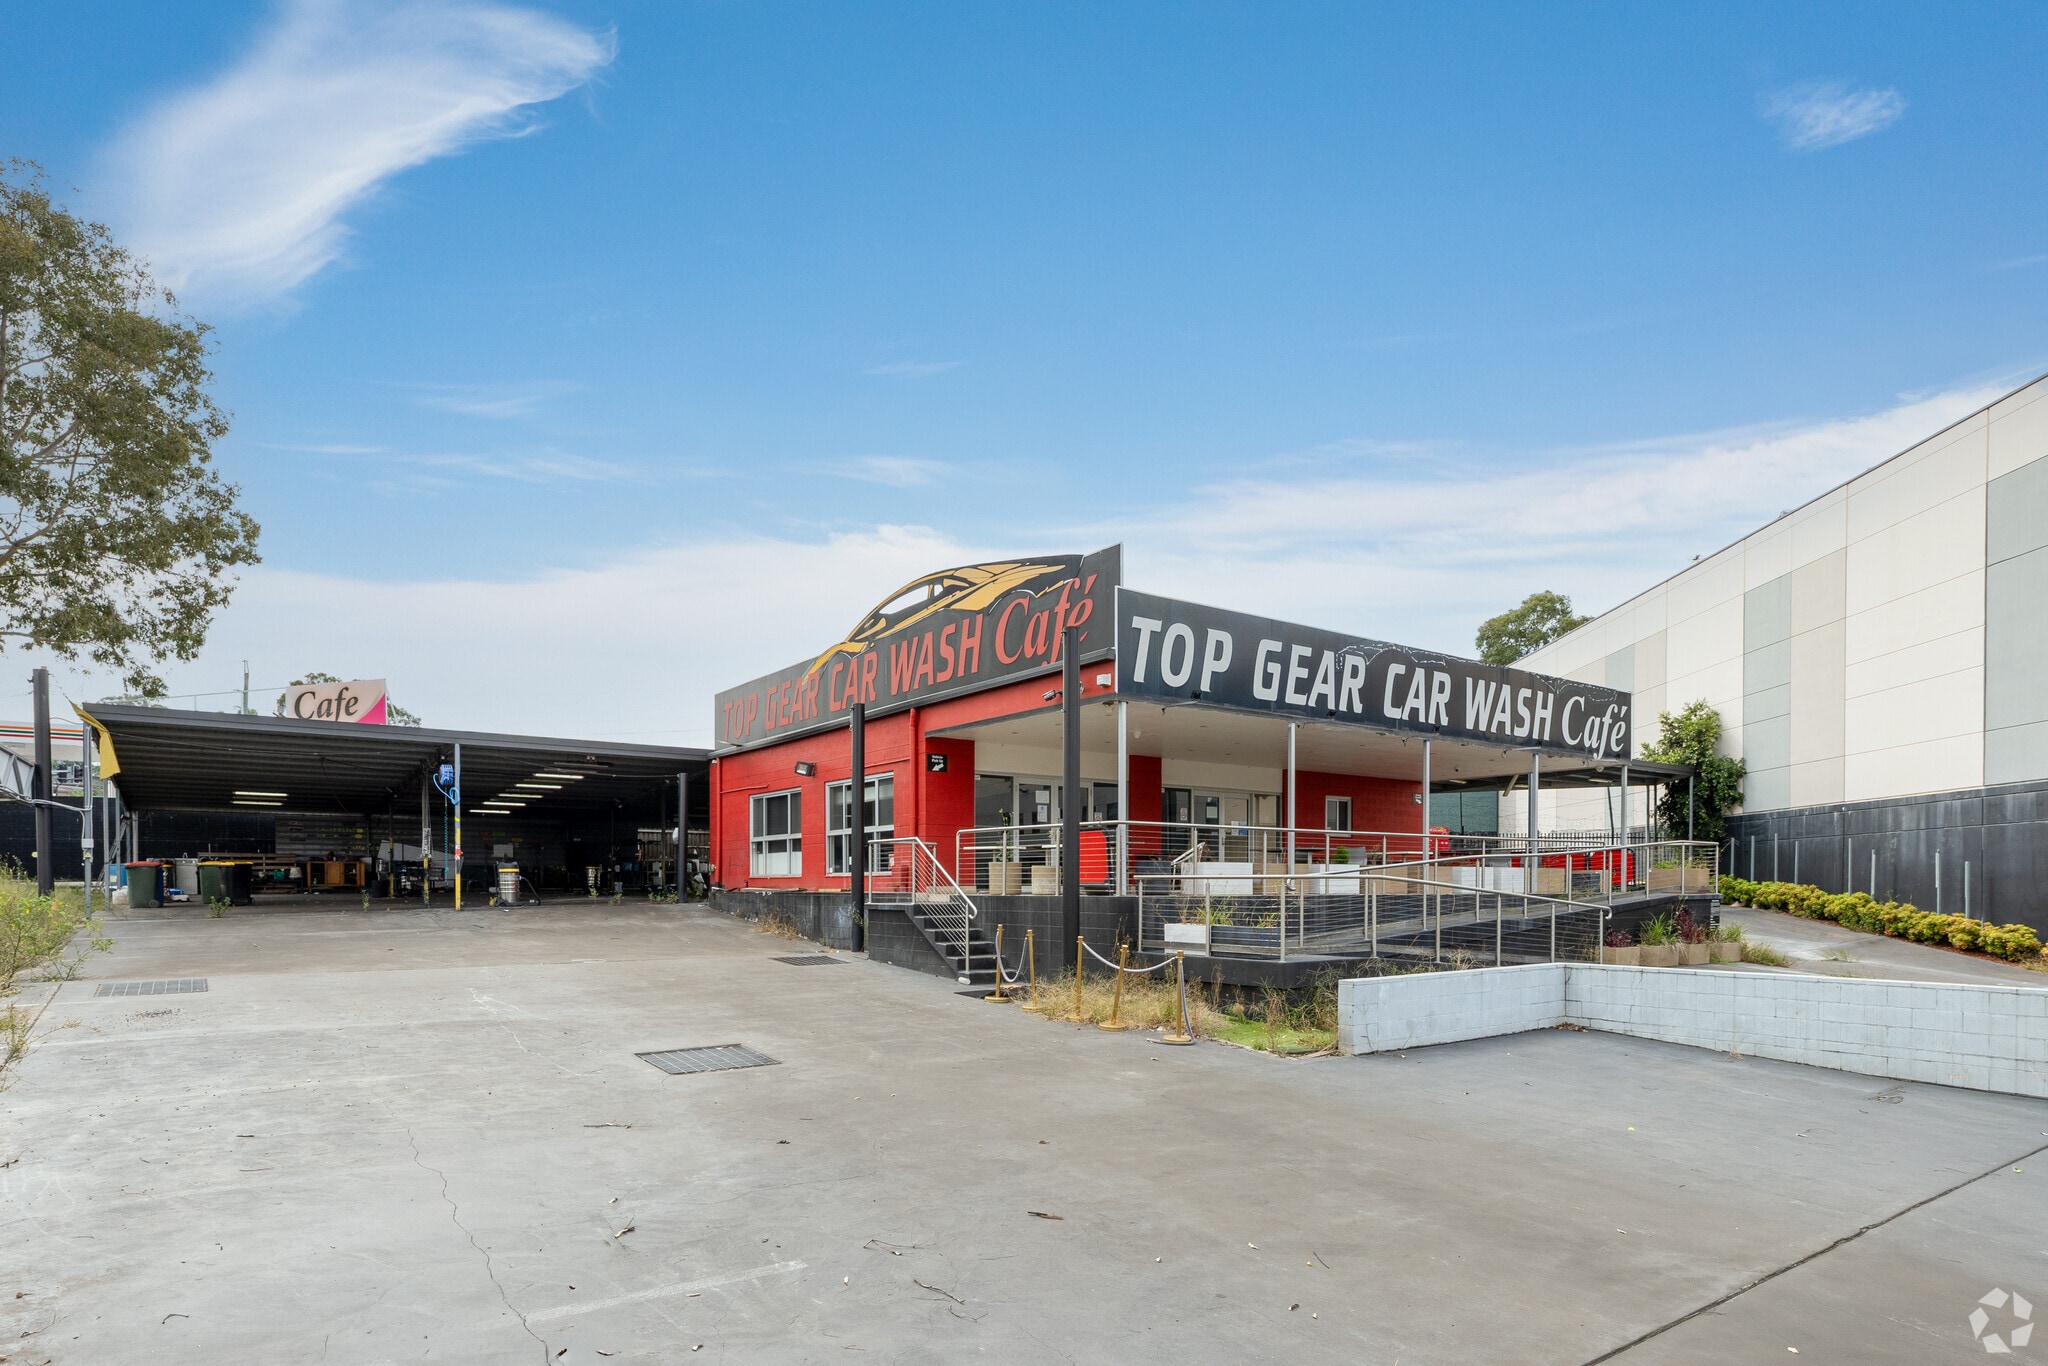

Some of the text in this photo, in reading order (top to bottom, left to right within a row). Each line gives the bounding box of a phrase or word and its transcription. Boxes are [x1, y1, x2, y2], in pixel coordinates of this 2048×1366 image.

[294, 686, 359, 721] Cafe
[723, 573, 1098, 741] TOP GEAR CAR WASH Café
[1132, 616, 1628, 760] TOP GEAR CAR WASH Café
